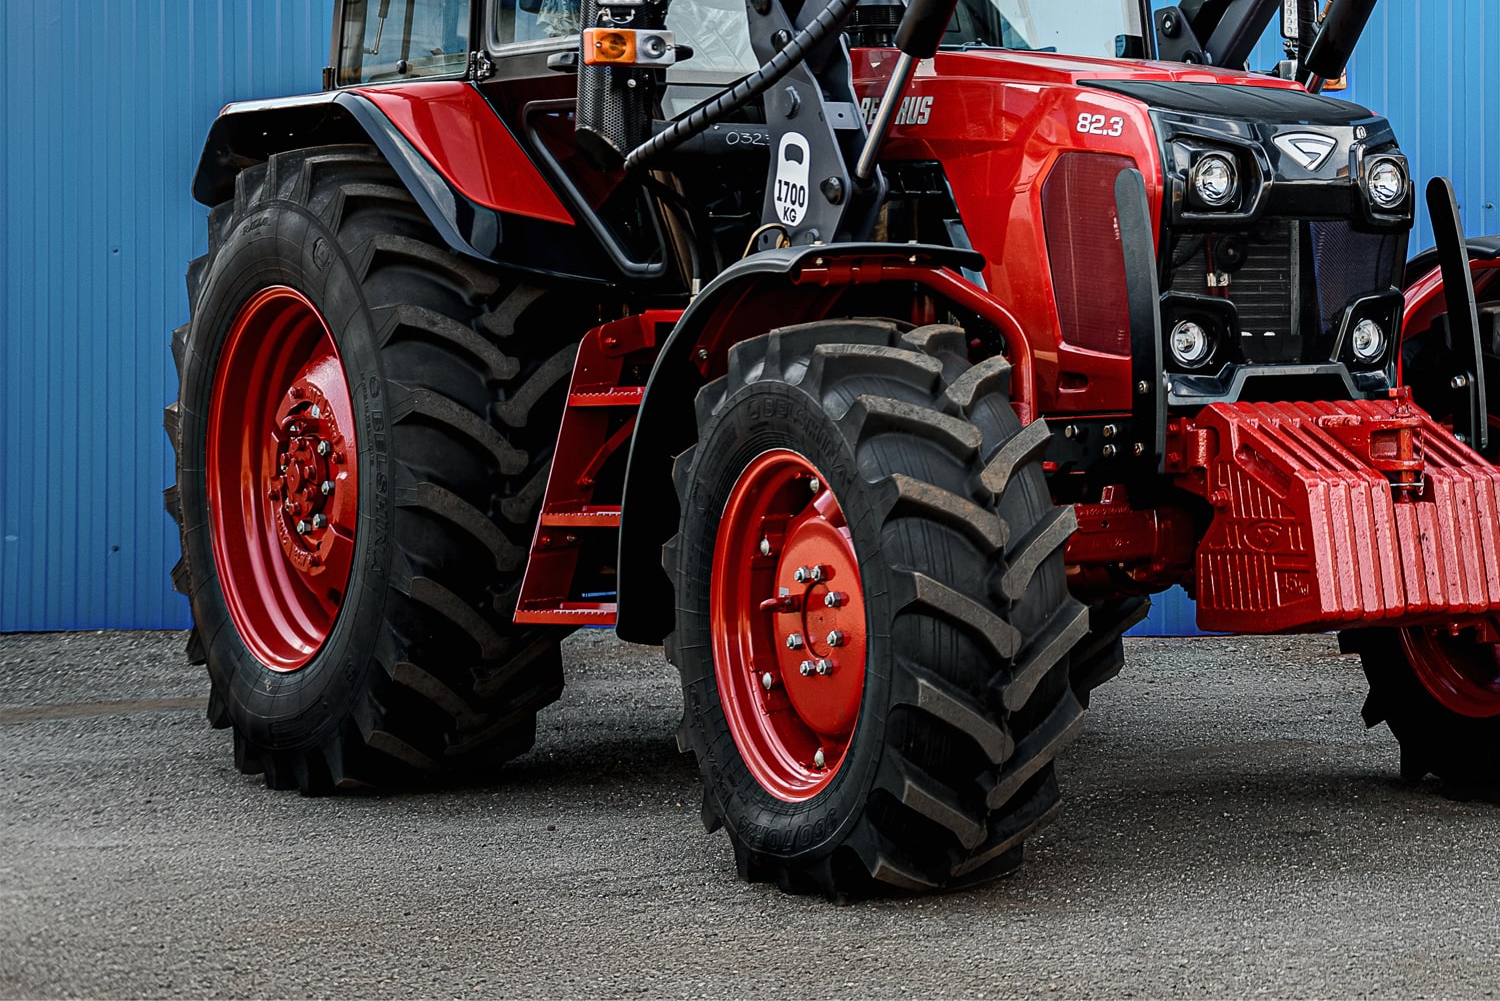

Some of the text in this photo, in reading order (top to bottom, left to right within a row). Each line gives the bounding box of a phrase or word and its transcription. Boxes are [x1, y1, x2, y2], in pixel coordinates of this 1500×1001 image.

[860, 96, 933, 125] BERUS
[1076, 112, 1124, 137] 82.3
[776, 179, 806, 208] 1700
[782, 206, 797, 223] KG
